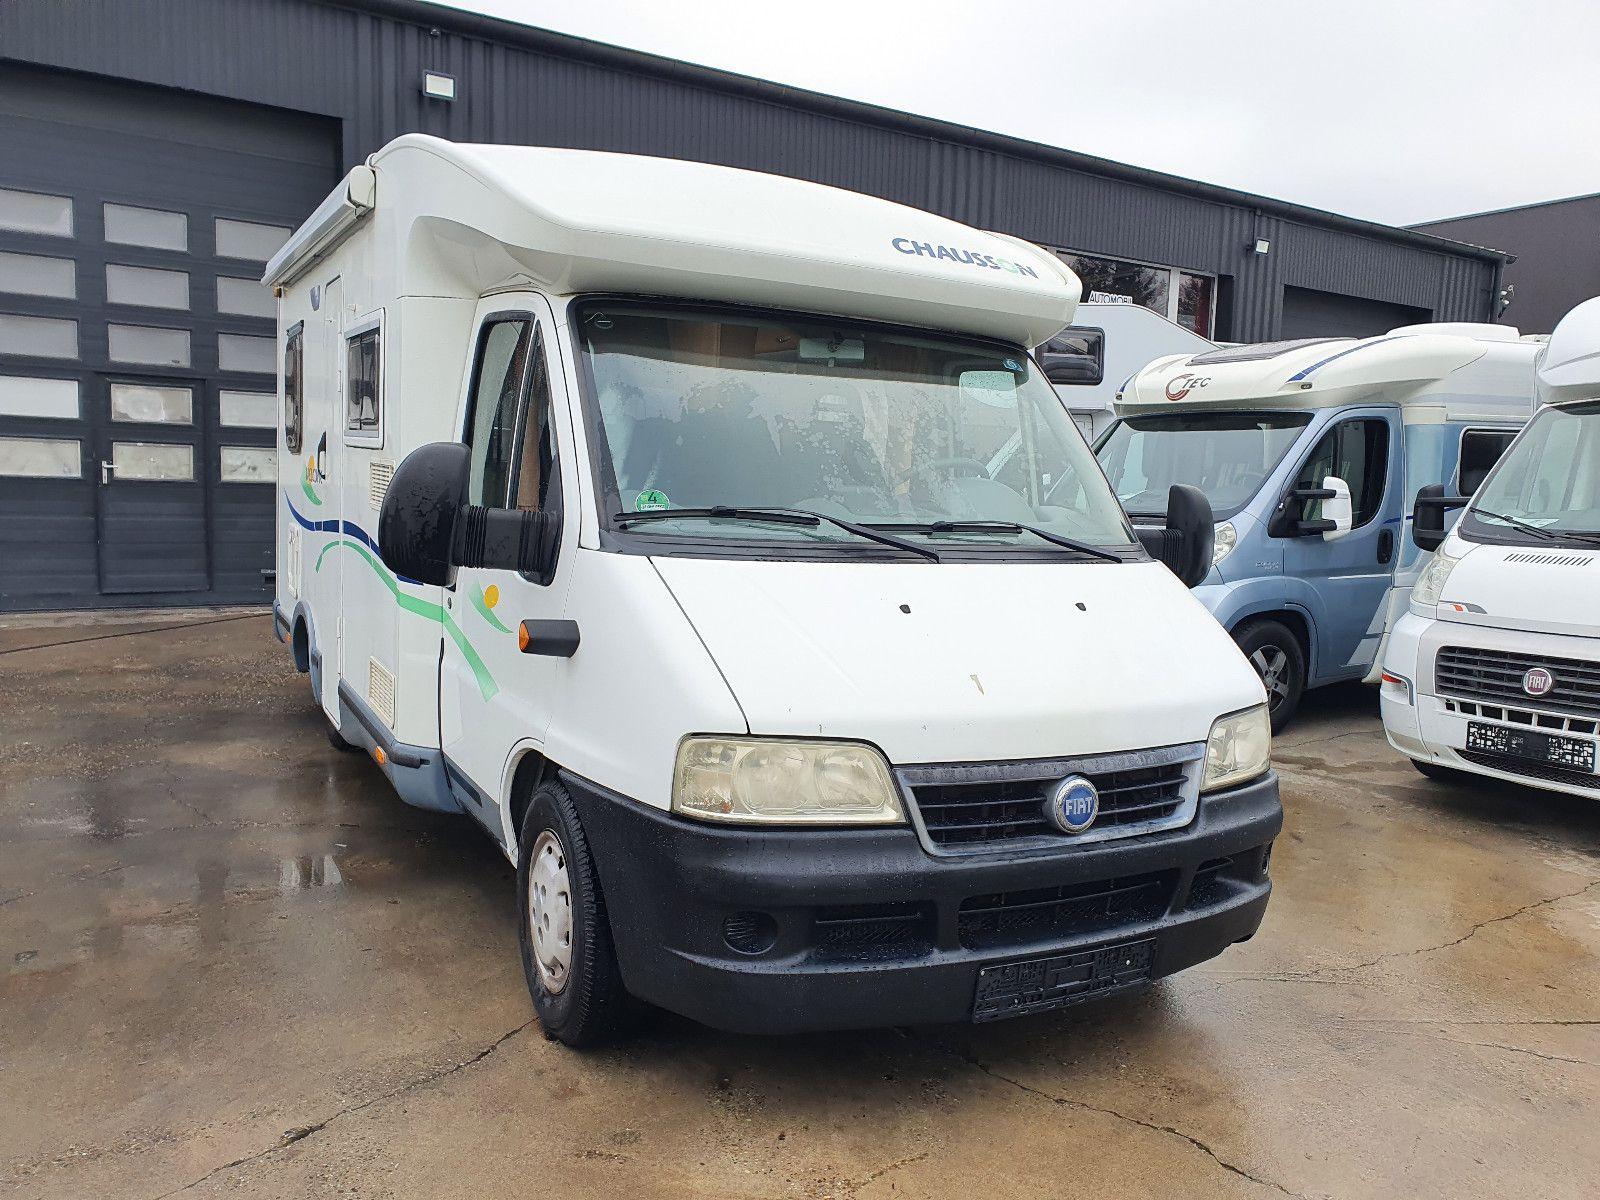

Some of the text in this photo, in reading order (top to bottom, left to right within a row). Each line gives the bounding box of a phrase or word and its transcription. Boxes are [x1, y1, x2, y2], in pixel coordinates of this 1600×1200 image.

[892, 237, 1039, 279] CHAUSSON
[647, 491, 658, 504] 4
[1528, 675, 1547, 689] FIAT
[1065, 796, 1093, 816] FIAT
